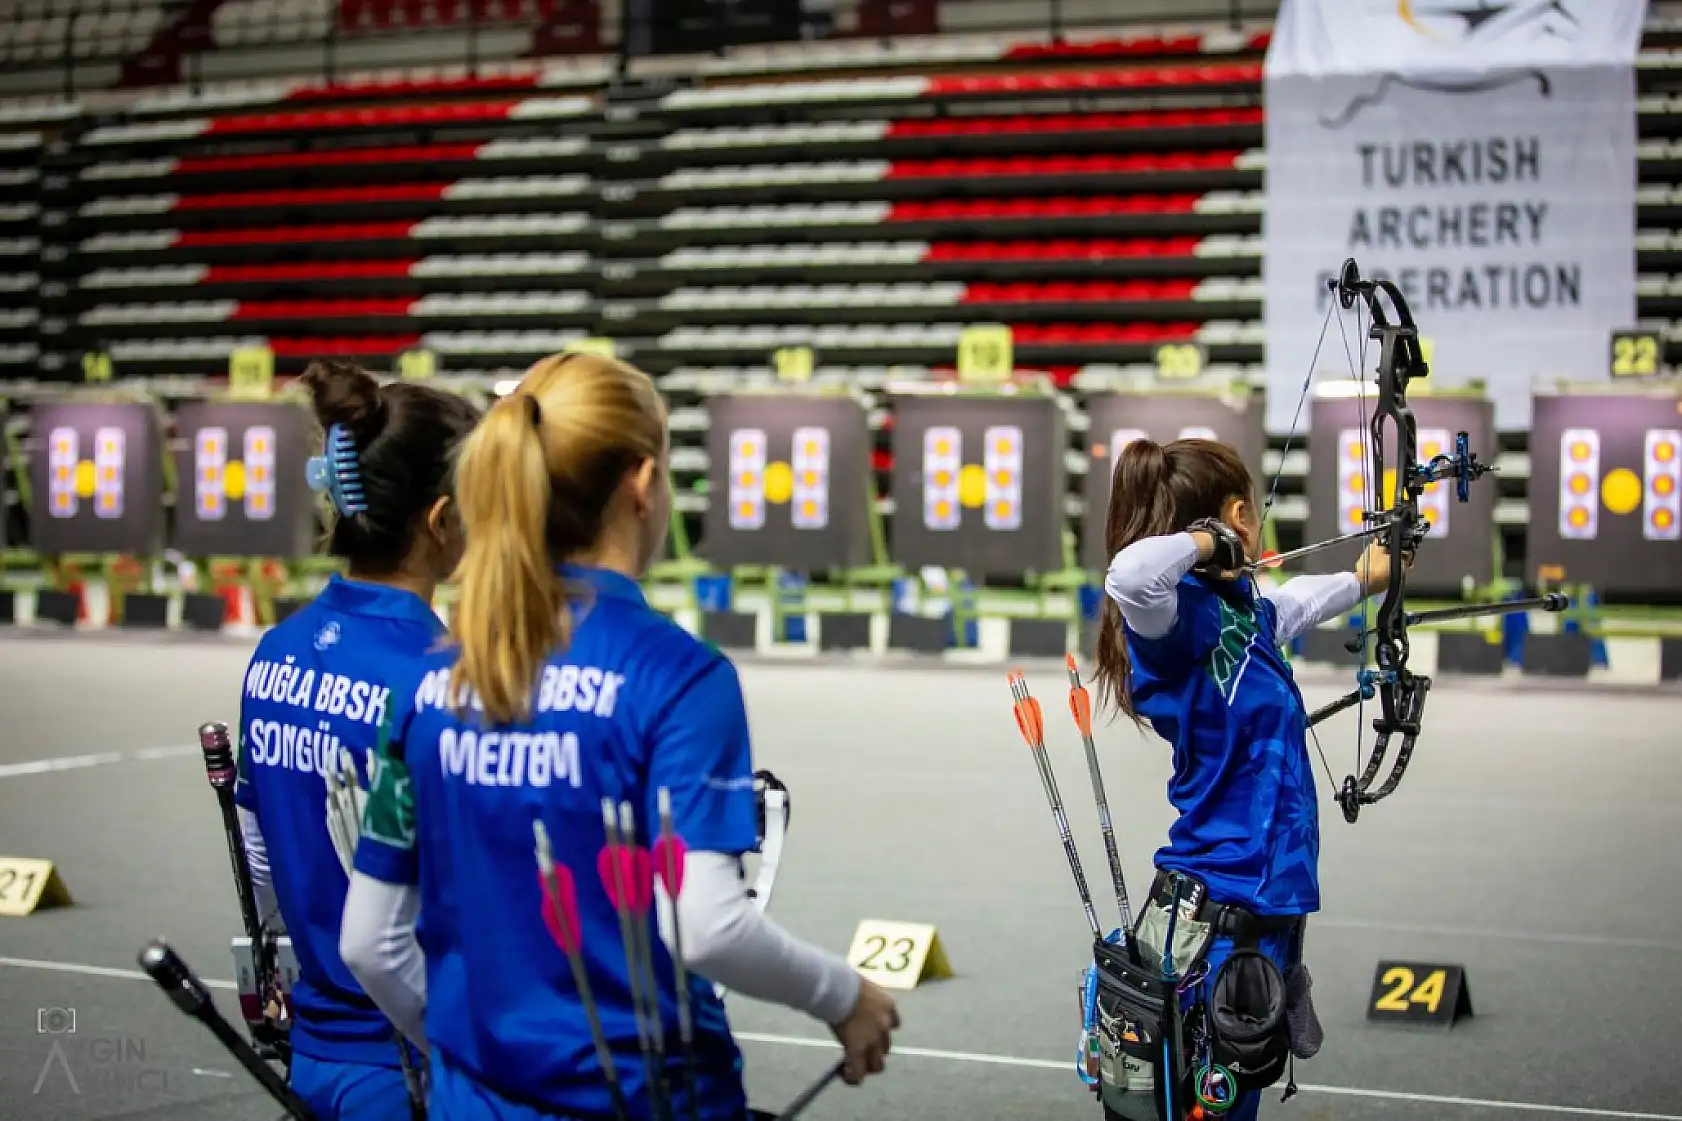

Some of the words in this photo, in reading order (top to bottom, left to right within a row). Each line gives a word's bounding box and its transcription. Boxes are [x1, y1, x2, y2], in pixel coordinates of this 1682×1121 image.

[1358, 136, 1541, 188] TURKISH
[1348, 201, 1550, 250] ARCHERY
[1315, 264, 1583, 313] FERATION
[1613, 336, 1656, 375] 22
[247, 655, 315, 708] MUĞLA
[0, 868, 36, 902] 21
[858, 935, 915, 972] 23
[1375, 966, 1447, 1013] 24
